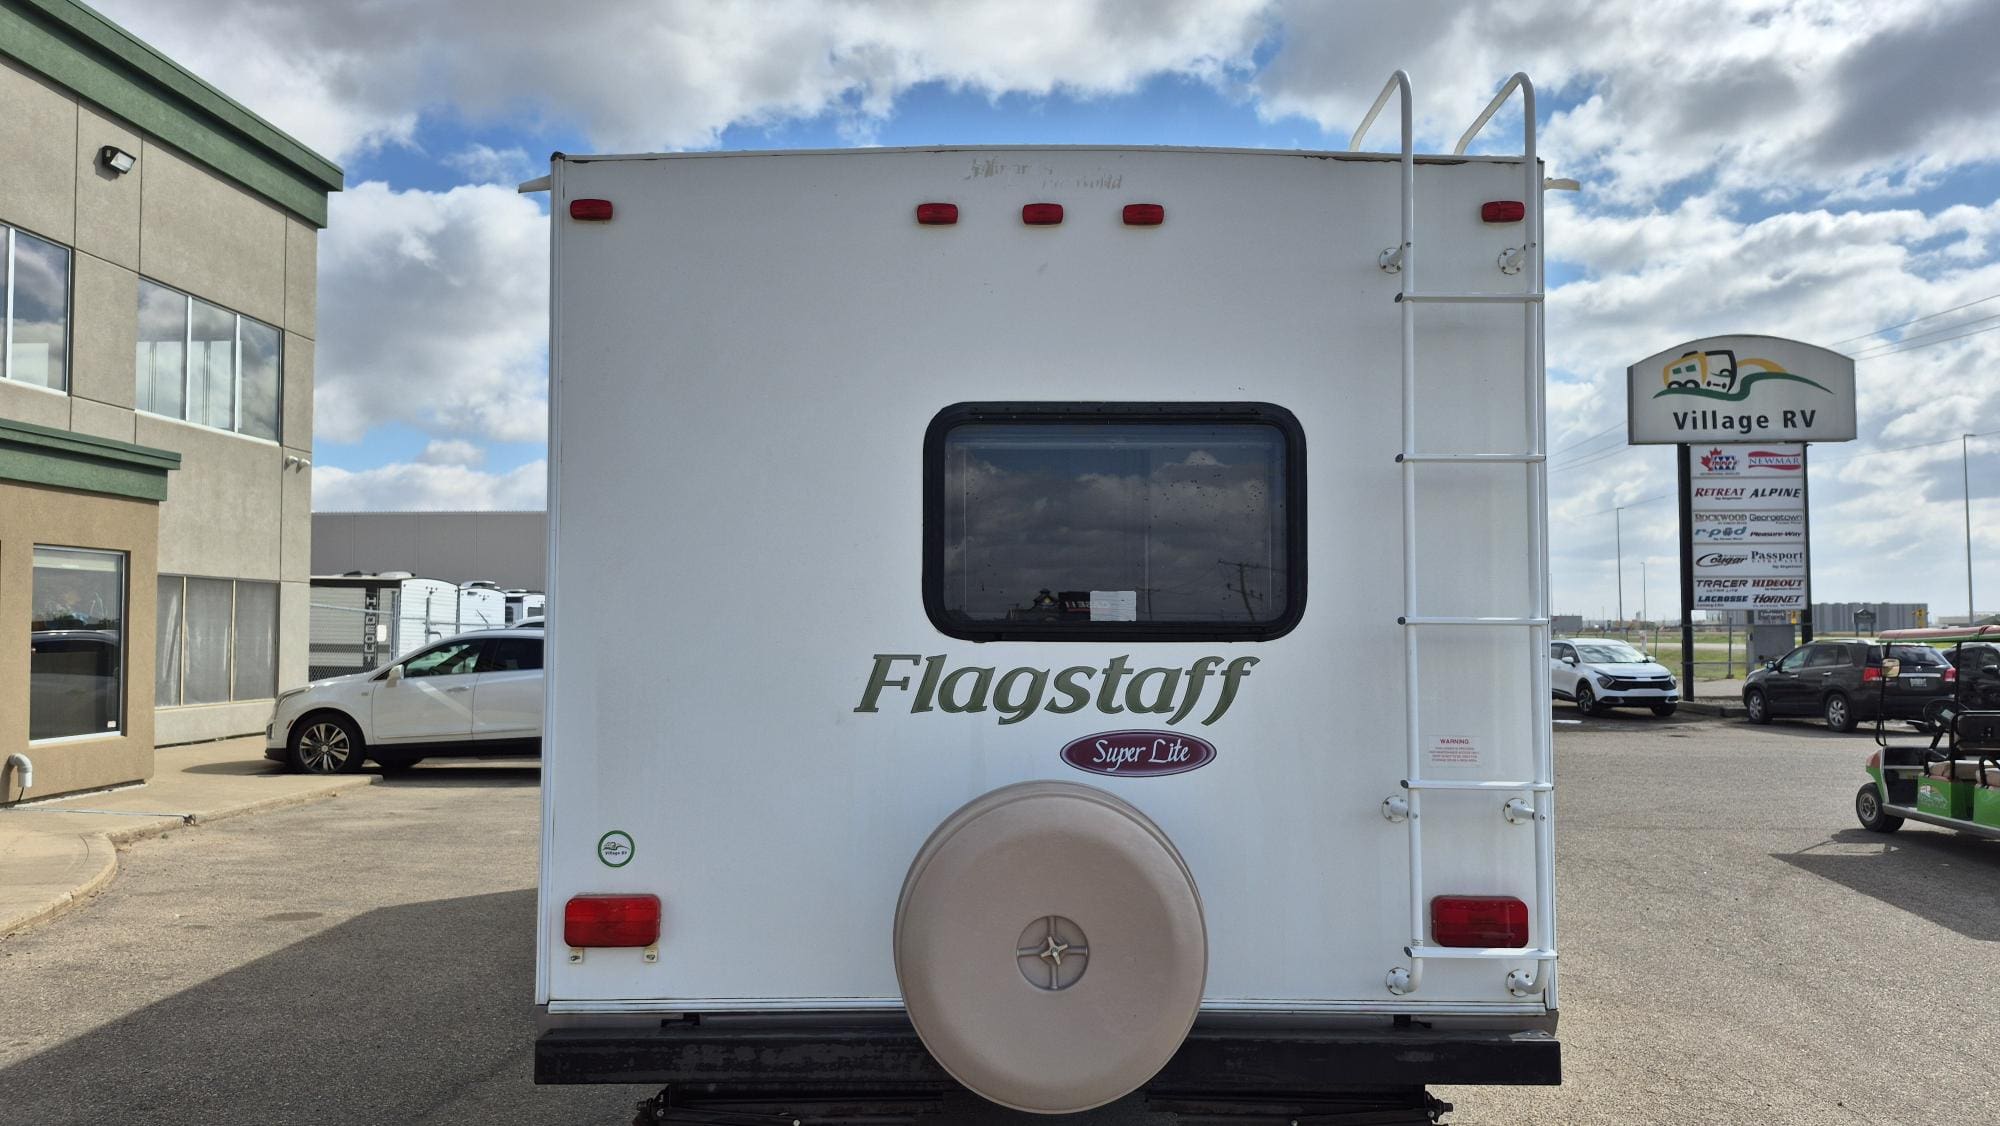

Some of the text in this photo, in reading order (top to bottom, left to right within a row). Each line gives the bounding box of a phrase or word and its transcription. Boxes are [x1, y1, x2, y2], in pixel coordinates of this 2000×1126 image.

[1673, 410, 1816, 434] Village RV
[1749, 457, 1799, 465] NEWMAR
[1695, 488, 1746, 497] RETREAT
[1749, 488, 1801, 498] ALPINE
[1749, 513, 1802, 521] Georgetown
[1696, 552, 1747, 567] Cougar
[1751, 550, 1803, 561] Passport
[1696, 579, 1748, 588] TRACER
[1751, 579, 1803, 588] HIDEOUT
[853, 653, 1261, 727] Flagstaff
[1093, 738, 1190, 772] Super Lite
